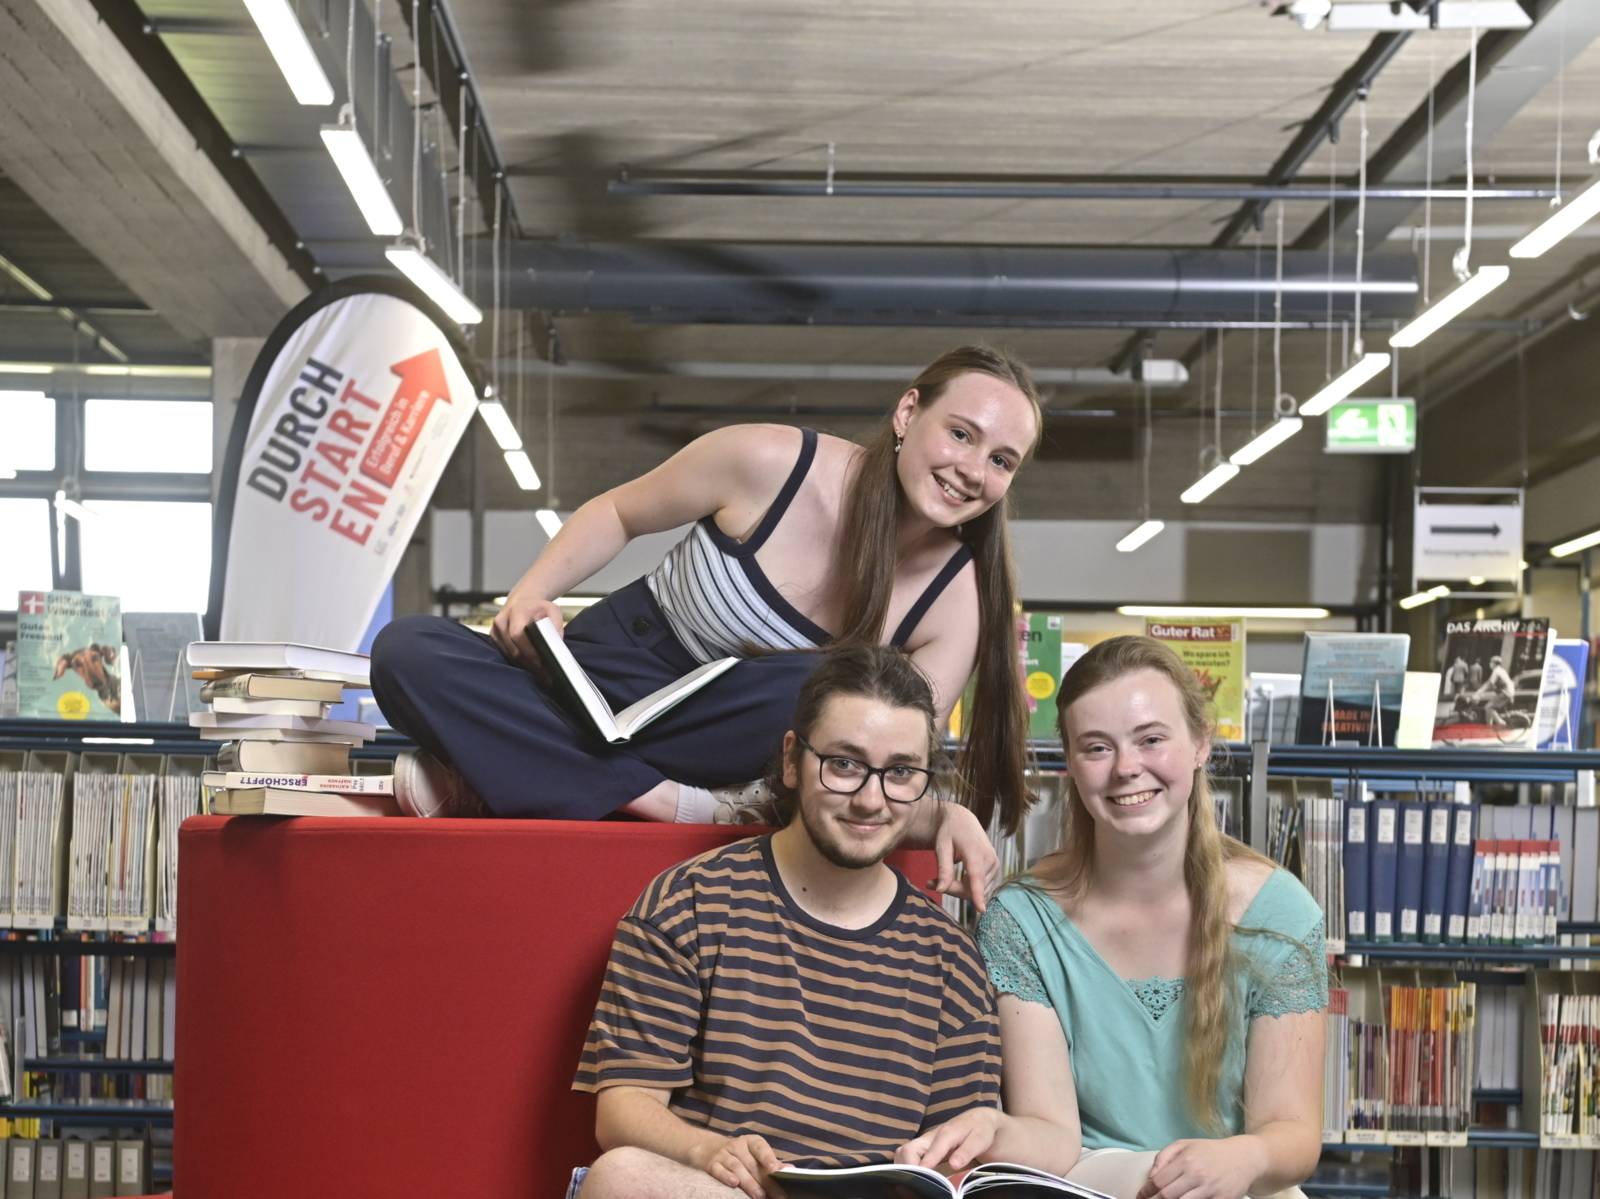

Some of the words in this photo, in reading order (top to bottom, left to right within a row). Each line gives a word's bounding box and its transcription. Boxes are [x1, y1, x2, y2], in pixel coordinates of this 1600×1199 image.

[246, 357, 344, 502] DURCH
[289, 378, 382, 522] START
[366, 410, 403, 468] Erfolgreich
[395, 397, 409, 411] in
[379, 444, 402, 475] Beruf
[393, 433, 408, 446] &
[401, 389, 430, 433] Karriere
[329, 482, 388, 546] EN
[1151, 624, 1190, 637] Guter
[1191, 626, 1216, 638] Rat
[1195, 651, 1217, 659] spare
[1446, 621, 1472, 634] DAS
[1472, 619, 1520, 633] ARCHIV
[240, 777, 308, 788] ERSCHÖPFT?
